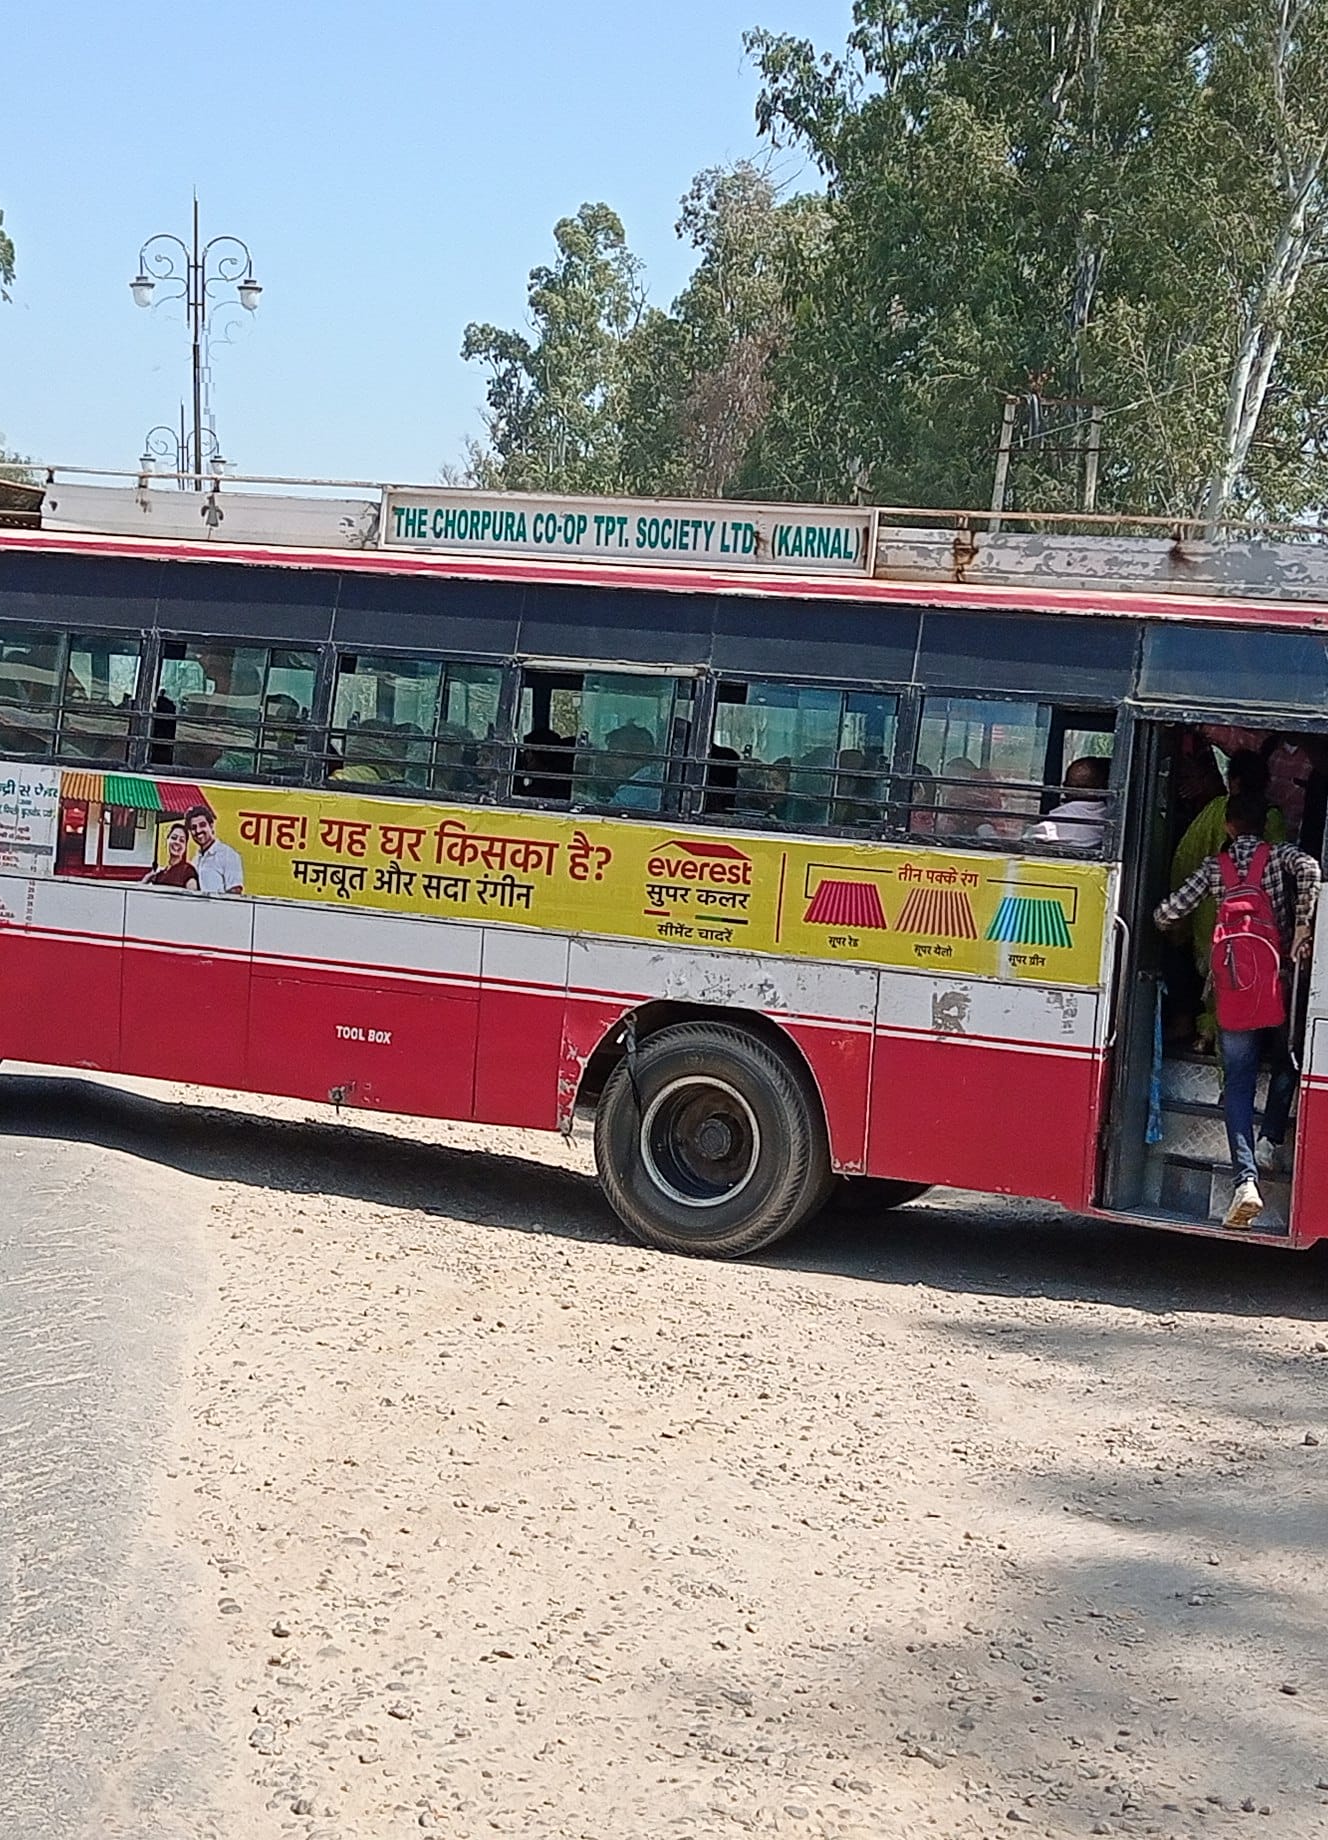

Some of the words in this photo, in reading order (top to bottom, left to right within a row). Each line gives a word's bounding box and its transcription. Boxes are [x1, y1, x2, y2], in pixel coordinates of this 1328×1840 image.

[393, 507, 428, 538] THE
[433, 508, 527, 543] CHORPURA
[533, 512, 588, 545] CO-OP
[594, 515, 629, 548] TPT.
[635, 516, 716, 551] SOCIETY
[771, 524, 861, 563] (KARNAL)
[238, 811, 308, 851] वाह!
[319, 818, 371, 858] यह
[379, 824, 427, 863] घर
[434, 819, 560, 876] किसका
[567, 830, 614, 882] है?
[291, 859, 366, 901] मज़बूत
[373, 860, 418, 898] और
[422, 873, 471, 902] सदा
[476, 872, 535, 909] रंगीन
[647, 857, 753, 886] everest
[898, 862, 923, 882] तीन
[926, 864, 959, 885] पक्के
[960, 868, 980, 888] रंग
[645, 884, 692, 907] सुपर
[695, 888, 751, 910] कलर
[697, 927, 734, 943] चादरें
[335, 1025, 366, 1041] TOOL
[367, 1029, 393, 1045] BOX
